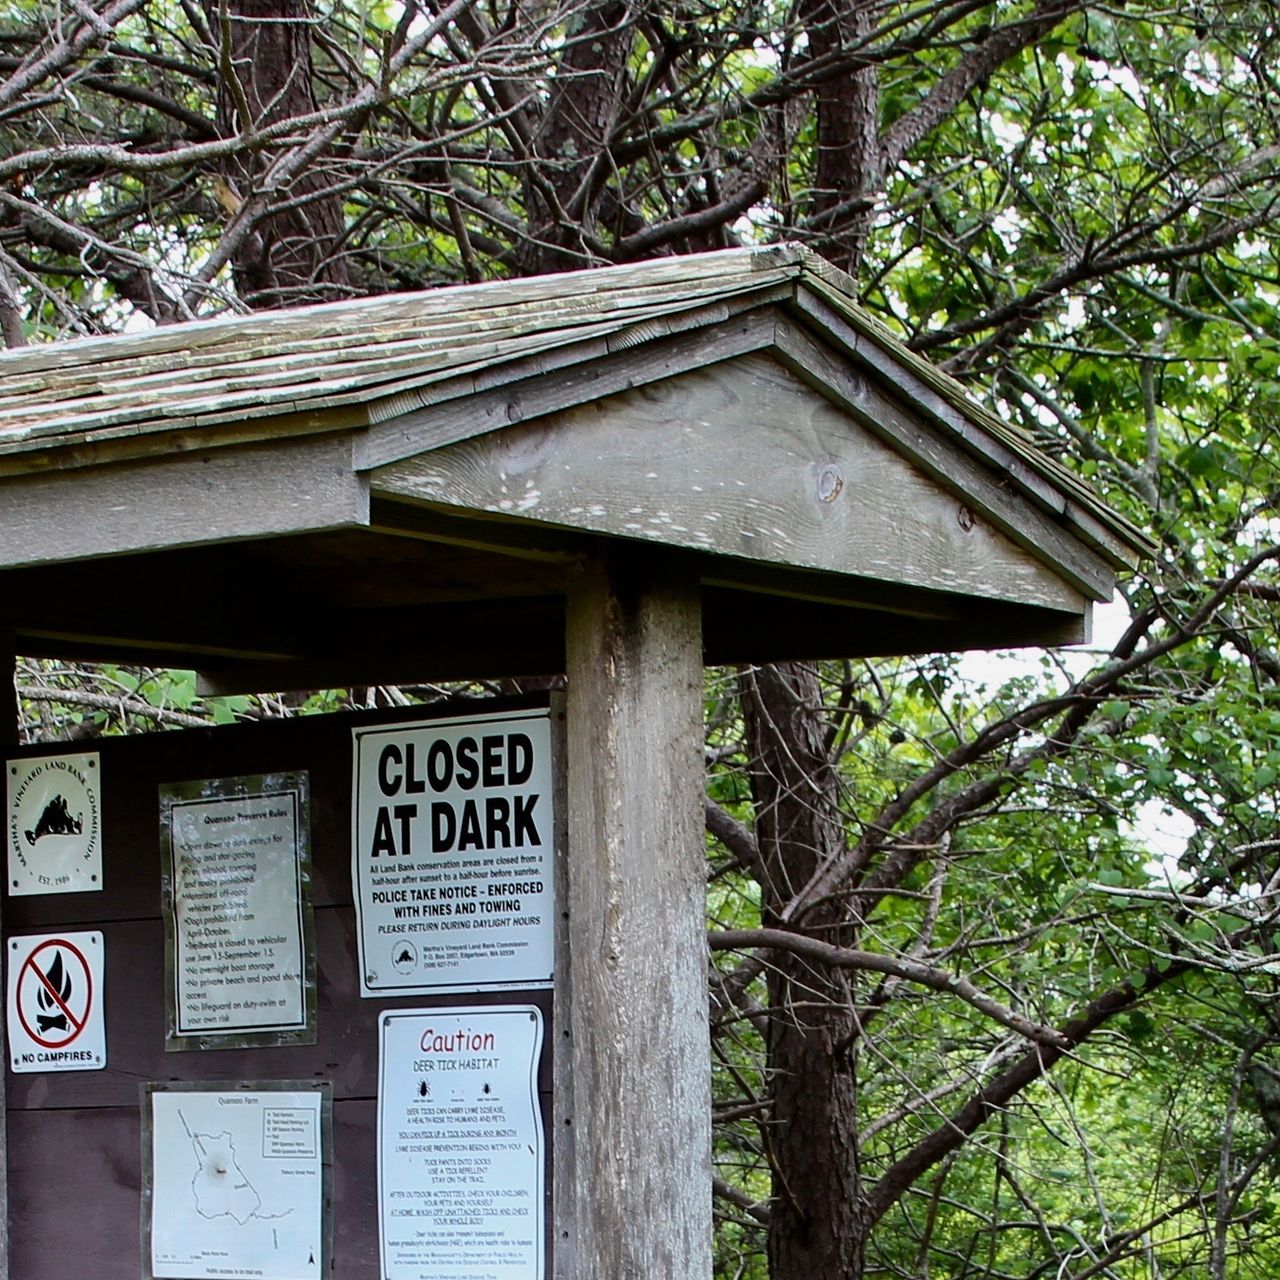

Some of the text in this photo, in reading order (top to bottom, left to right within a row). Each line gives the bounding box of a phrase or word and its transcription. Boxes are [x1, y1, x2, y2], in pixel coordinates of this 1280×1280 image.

[378, 732, 535, 798] CLOSED
[11, 760, 99, 867] MARTHA'S VINEYARD LAND BANK COMMISSION
[204, 808, 288, 825] Quansoo Preserve Rules
[371, 794, 542, 858] AT DARK
[370, 853, 544, 874] All Land Bank conservation areas are closed from a
[38, 874, 55, 886] EST.
[372, 874, 400, 885] half-hour
[402, 873, 418, 883] after
[419, 872, 443, 883] sunset
[443, 872, 451, 881] to
[453, 872, 458, 880] a
[459, 869, 489, 880] half-hour
[490, 868, 512, 878] before
[372, 881, 544, 904] POLICE TAKE NOTICE ENFORCED
[393, 899, 521, 919] WITH FINES AND TOWING
[378, 915, 542, 934] PLEASE RETURN DURING DAYLIGHT HOURS
[200, 963, 229, 974] overnight
[231, 963, 247, 972] boat
[248, 961, 275, 973] storage
[200, 976, 224, 988] private
[225, 974, 246, 985] beach
[247, 973, 260, 983] and
[261, 972, 281, 984] pond
[186, 991, 207, 1000] access
[201, 1000, 231, 1013] lifeguard
[233, 1001, 241, 1010] on
[243, 998, 277, 1011] duty-swim
[278, 998, 286, 1007] at
[420, 1027, 495, 1052] Caution
[21, 1050, 92, 1064] NO CAMPFIRES
[413, 1058, 500, 1072] DEER TICK HABITAT
[218, 1096, 259, 1106] Quansoo Farm
